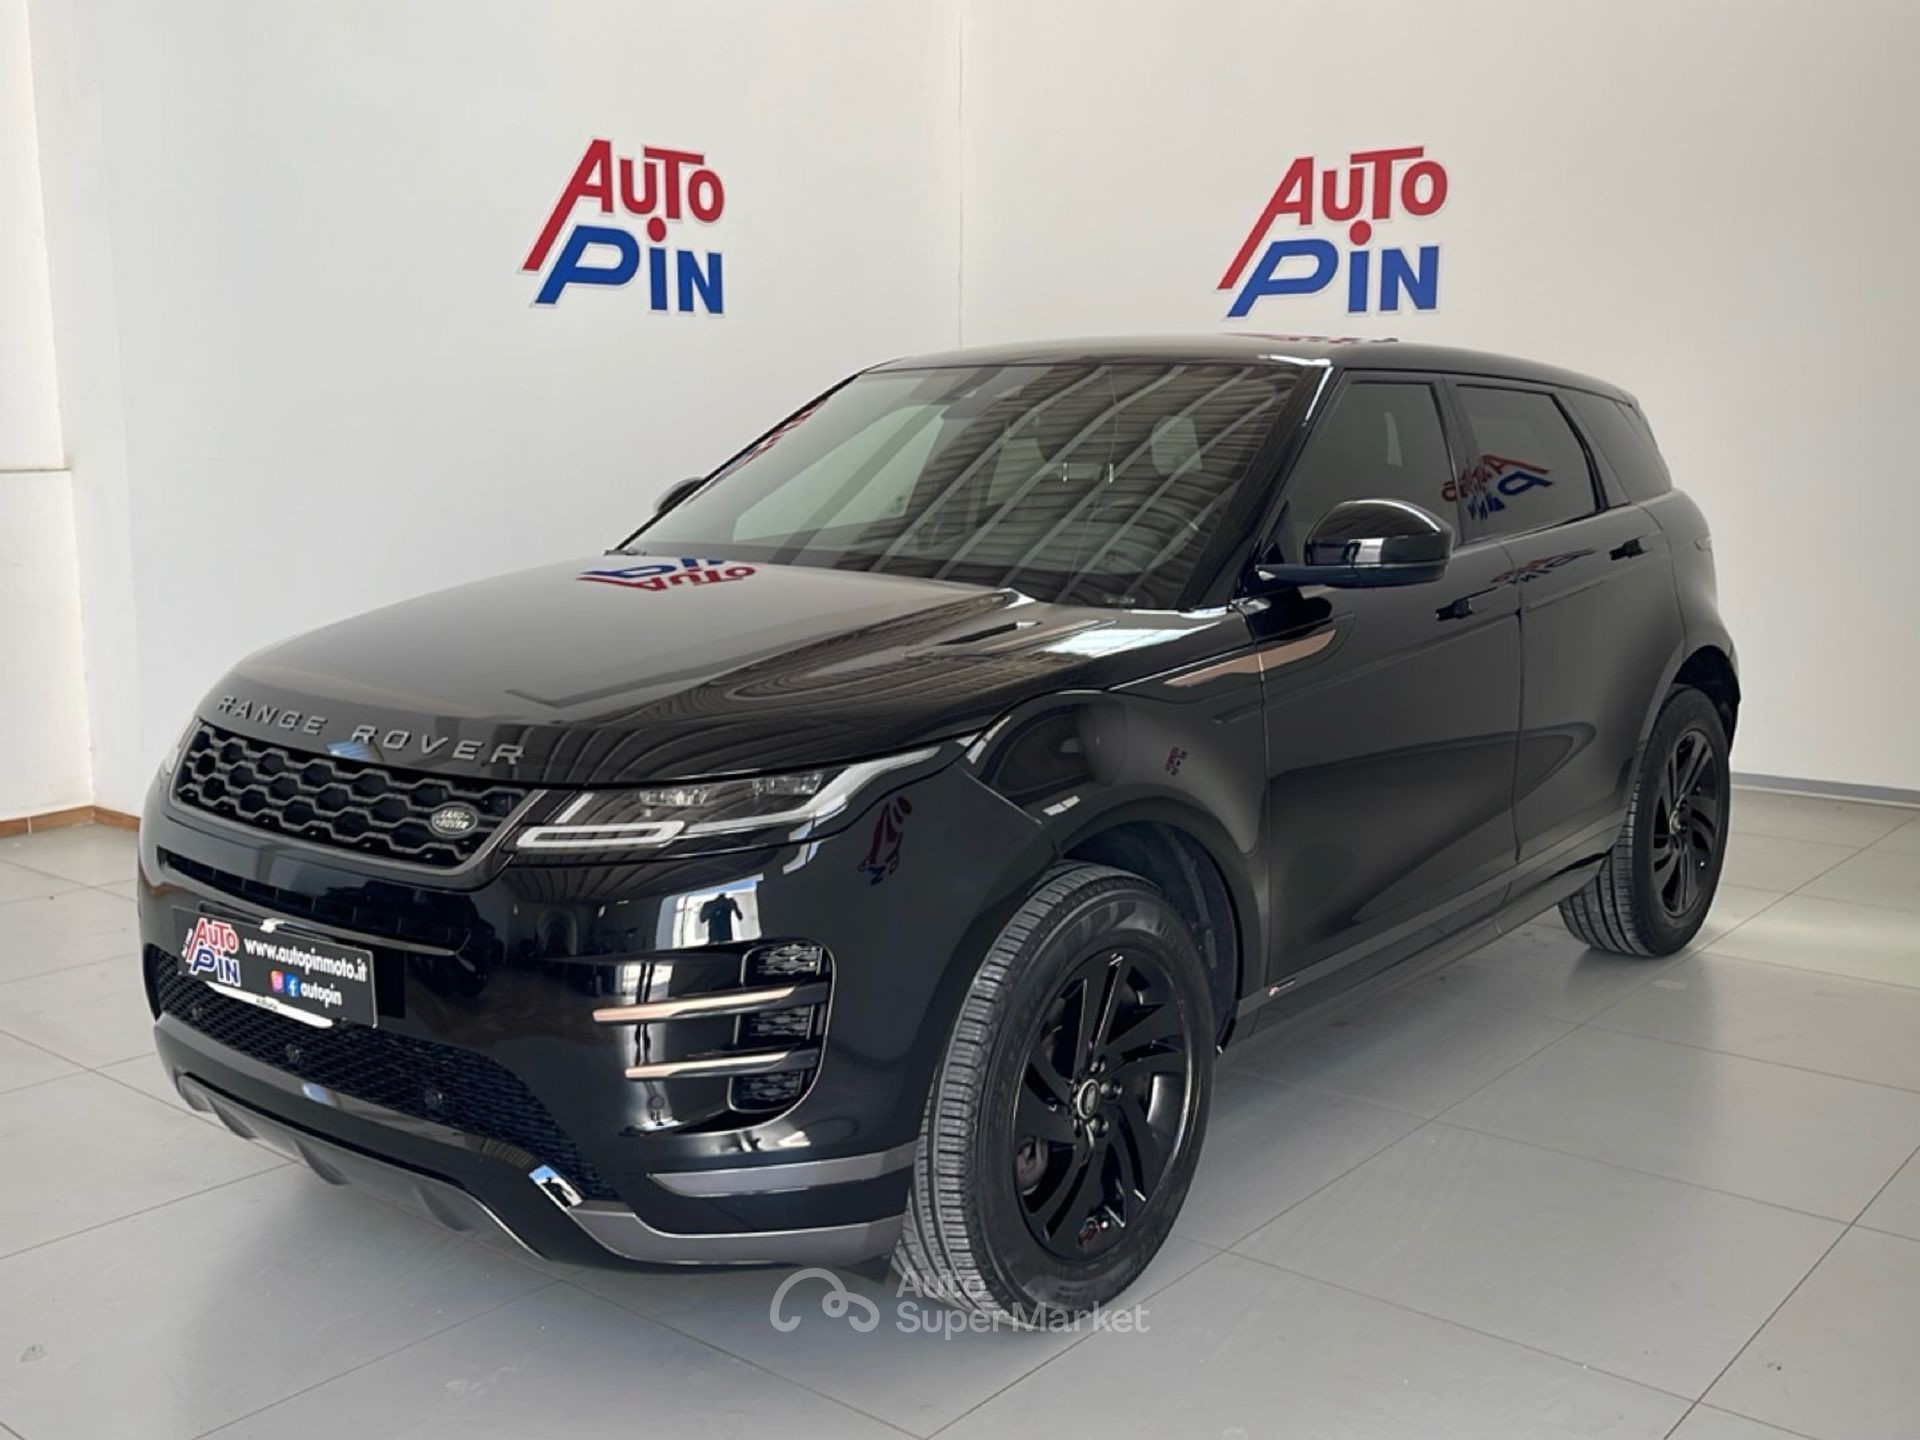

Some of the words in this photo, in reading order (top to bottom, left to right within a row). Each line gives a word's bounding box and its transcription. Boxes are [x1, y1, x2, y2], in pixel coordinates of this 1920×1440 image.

[217, 695, 329, 736] RANGE
[351, 724, 524, 765] ROVER
[243, 937, 367, 983] www.autopinmoto.it
[300, 982, 343, 1009] autopin
